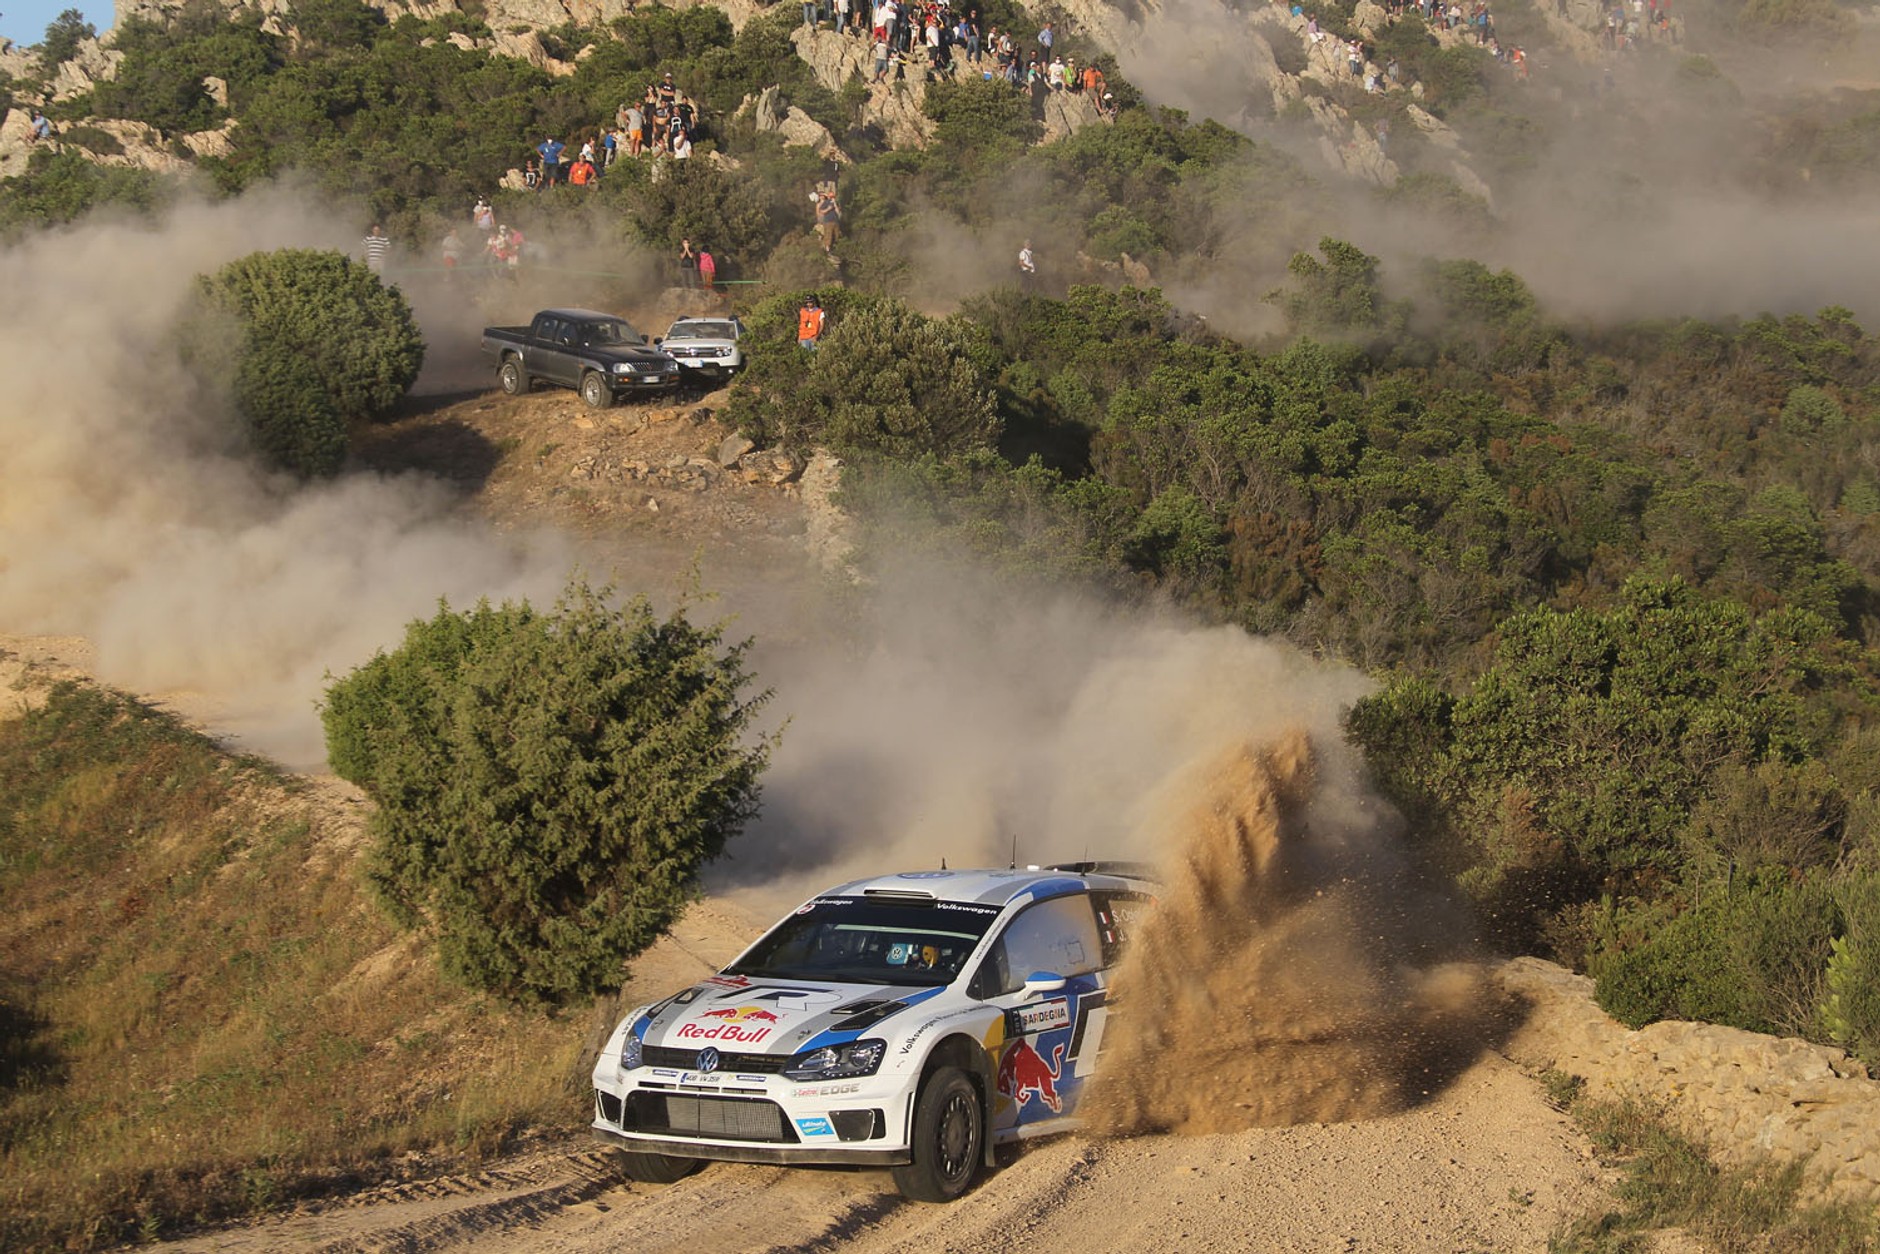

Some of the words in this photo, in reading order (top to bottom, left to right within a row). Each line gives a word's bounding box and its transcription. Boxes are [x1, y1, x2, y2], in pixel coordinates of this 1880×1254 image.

[936, 902, 998, 915] Volkswagen
[1023, 1007, 1066, 1026] SARDEGNA
[677, 1023, 726, 1039] Red
[720, 1026, 771, 1042] Bull
[899, 1018, 938, 1055] Volkswagen
[820, 1083, 861, 1096] EDGE
